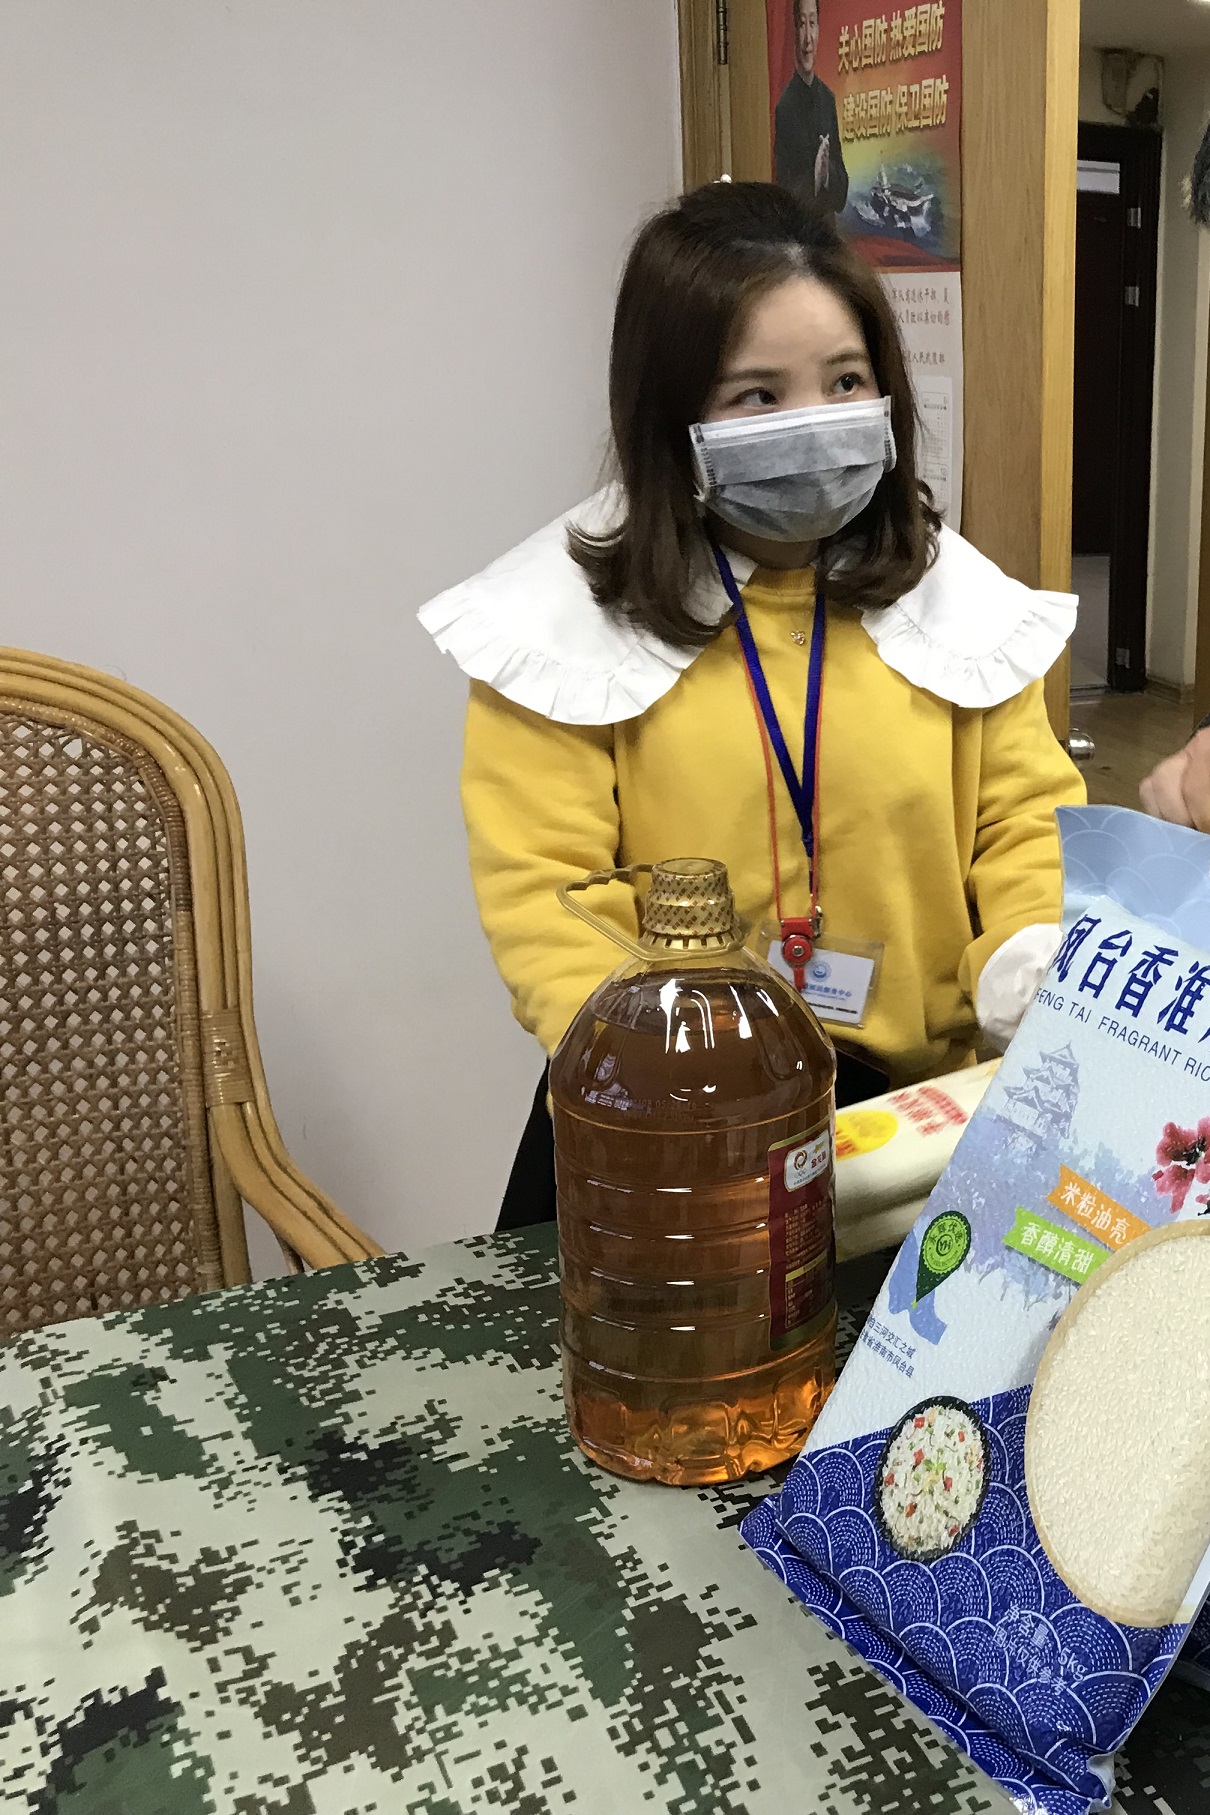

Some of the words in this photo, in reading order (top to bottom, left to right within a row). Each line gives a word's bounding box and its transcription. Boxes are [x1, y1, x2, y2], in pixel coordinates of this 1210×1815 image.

[1069, 1001, 1092, 1023] TAI
[1097, 1016, 1182, 1065] FRAGRANT
[1060, 1181, 1131, 1245] 米粒油亮
[1021, 1221, 1095, 1275] 香醇清甜
[993, 1626, 1067, 1695] 图片仅供参考
